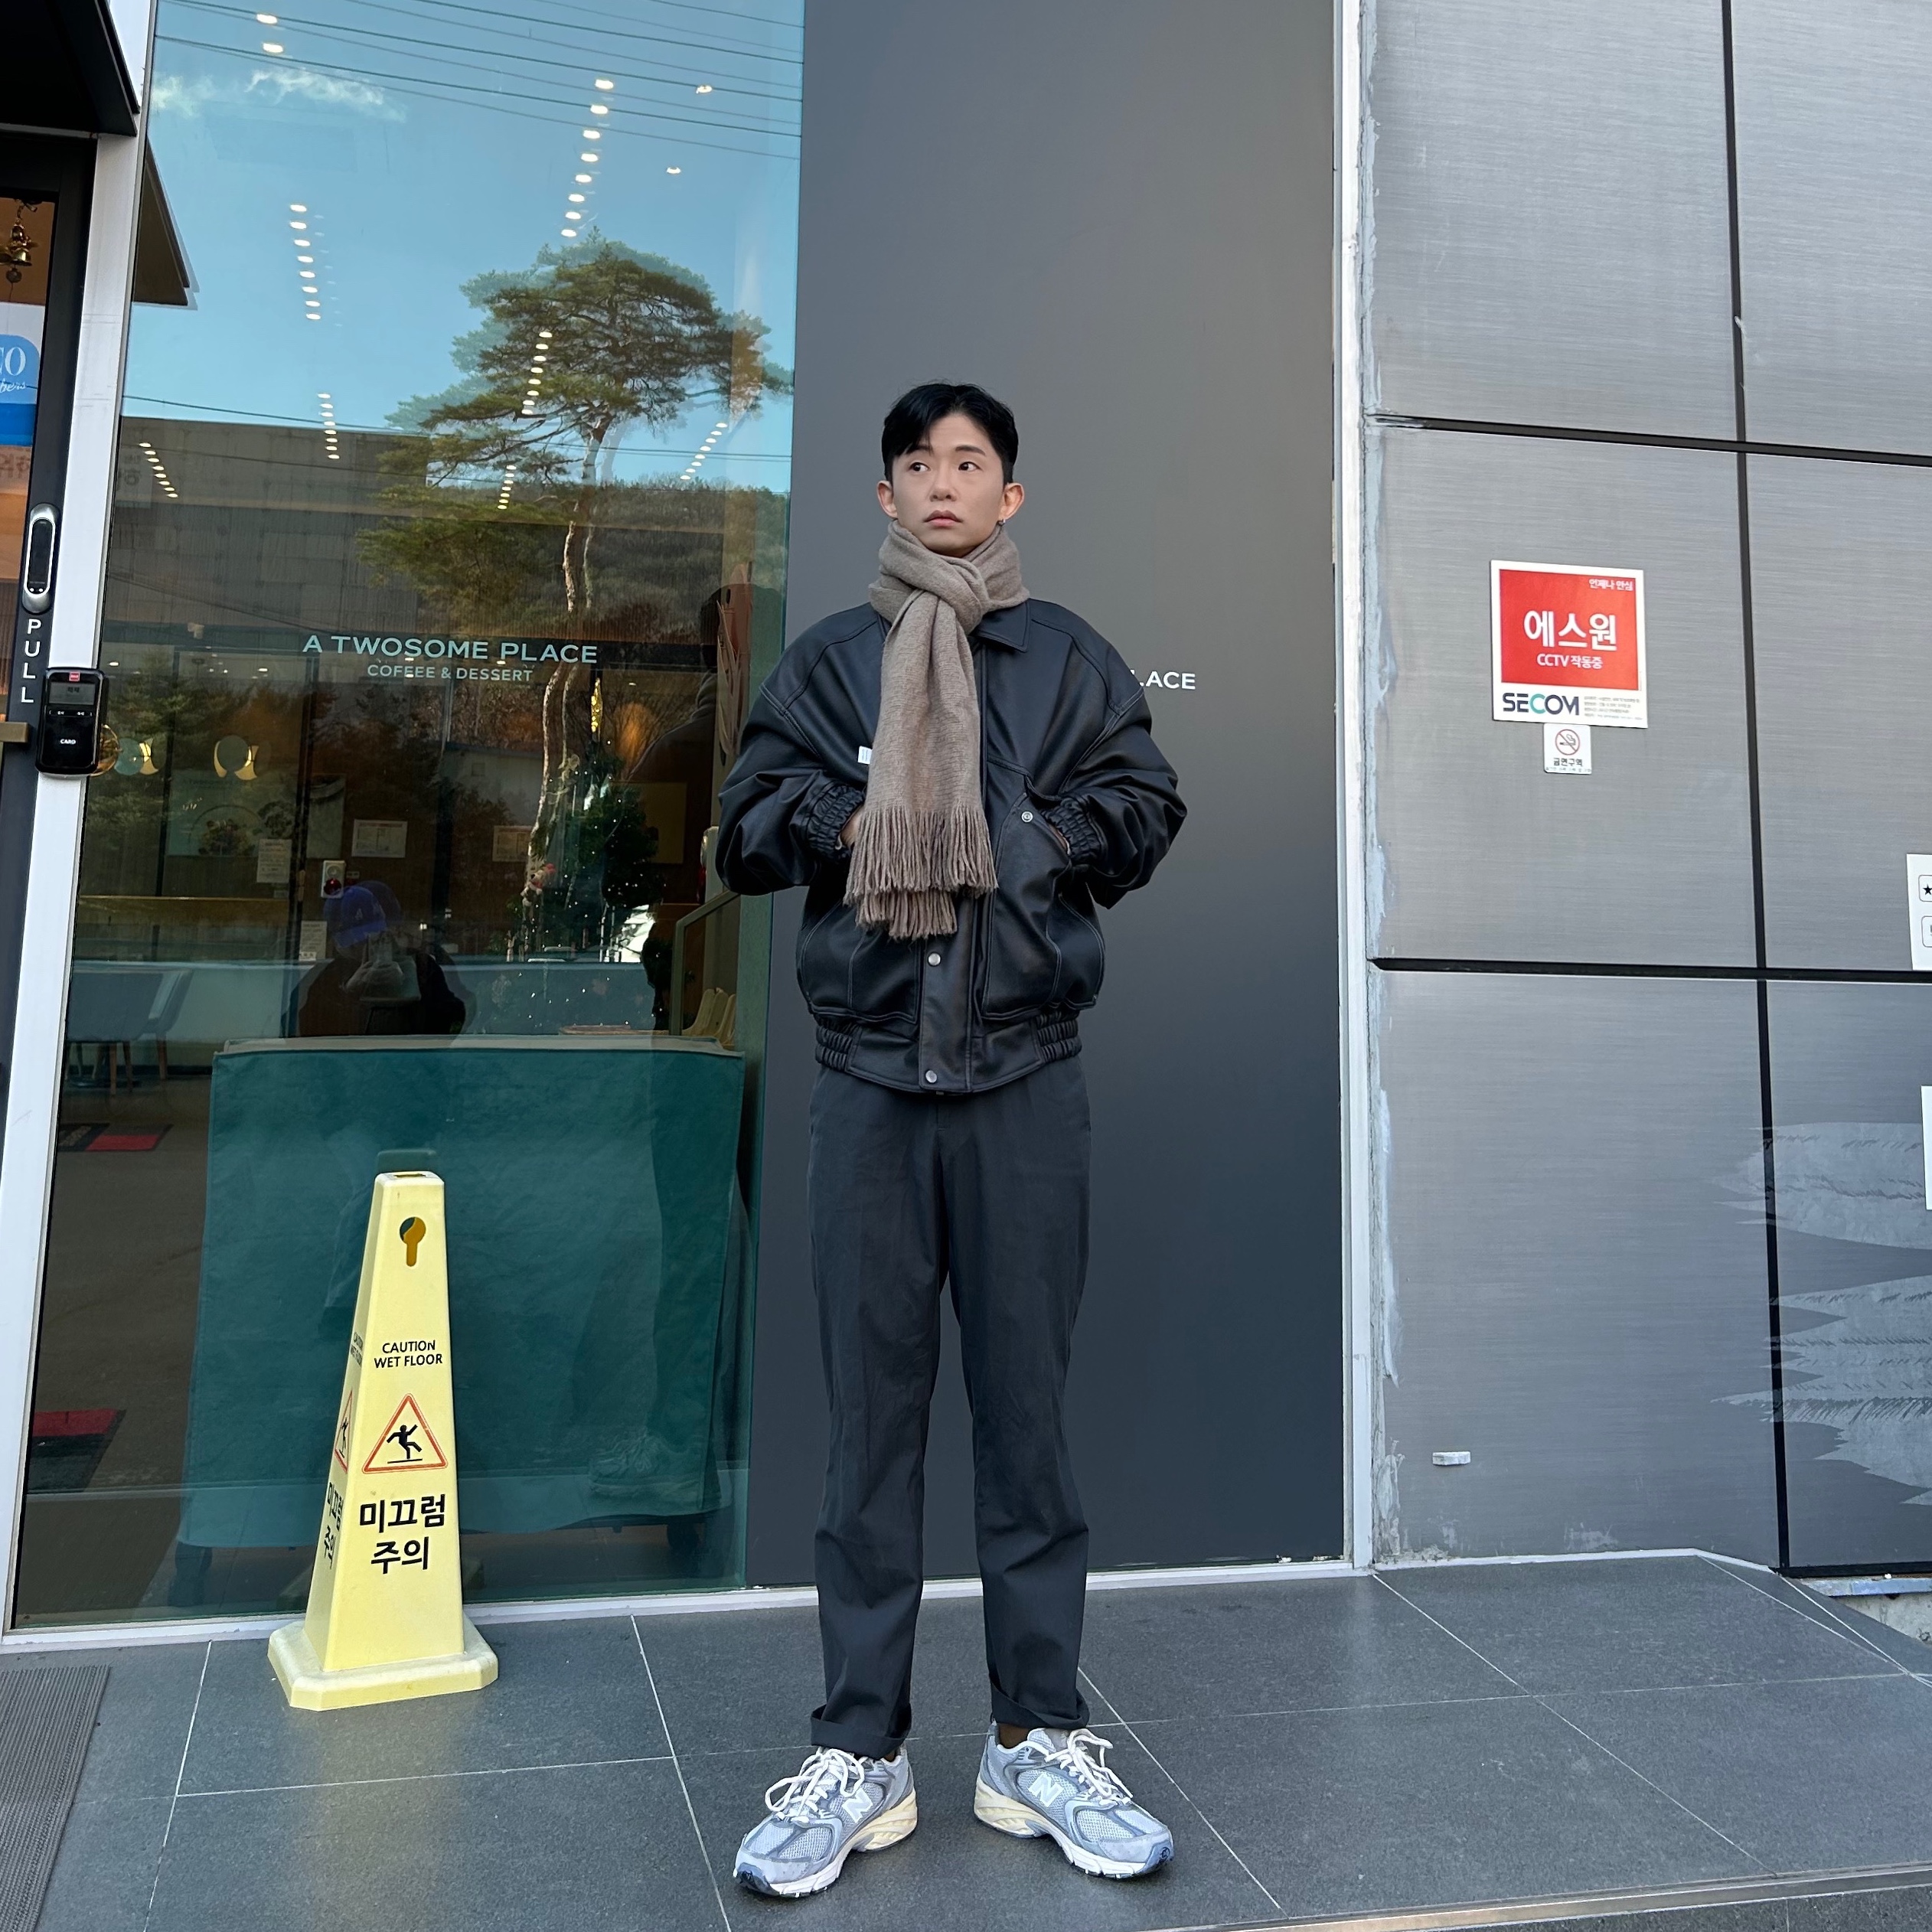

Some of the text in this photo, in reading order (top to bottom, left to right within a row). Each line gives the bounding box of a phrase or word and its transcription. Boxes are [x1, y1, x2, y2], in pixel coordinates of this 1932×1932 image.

[1588, 579, 1633, 592] 언제나 안심
[1524, 610, 1617, 651] 에스원
[21, 618, 42, 703] PULL
[302, 635, 598, 664] A TWOSOME PLACE
[367, 664, 534, 681] COFFEE & DESSERT
[1537, 654, 1603, 669] CCTV 작동중
[1130, 669, 1196, 690] ACE
[1503, 693, 1579, 716] SECOM
[382, 1340, 436, 1354] CAUTION
[374, 1356, 401, 1369] WET
[404, 1354, 443, 1366] FLOOR
[359, 1494, 445, 1533] 미끄럼
[370, 1536, 429, 1575] 주의
